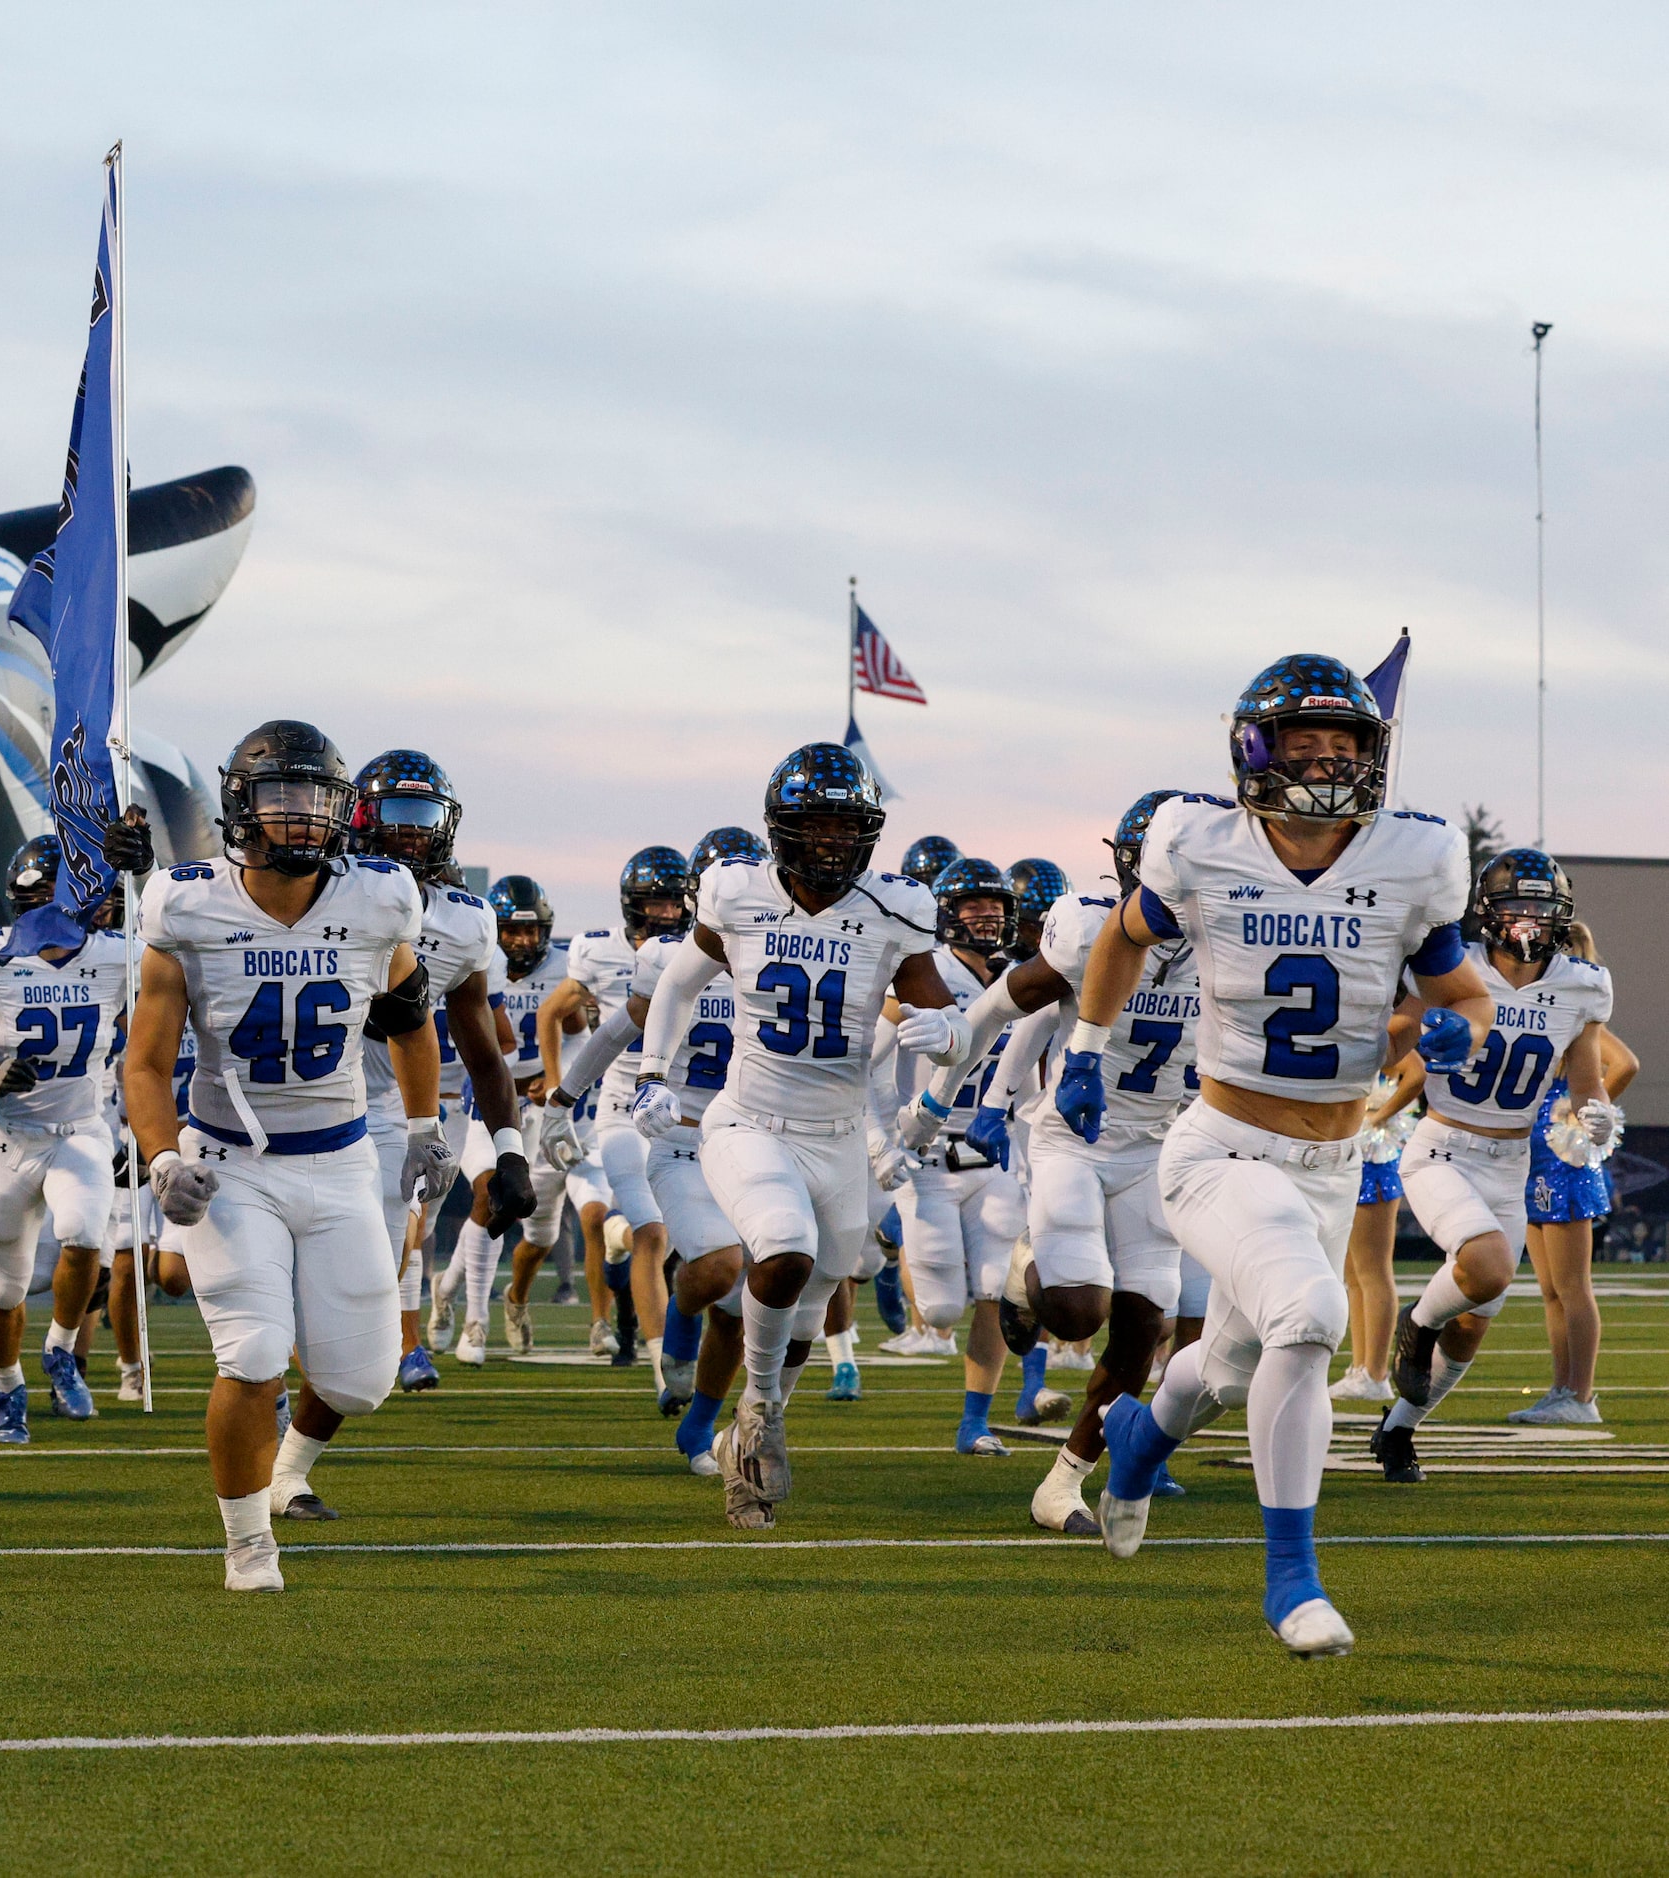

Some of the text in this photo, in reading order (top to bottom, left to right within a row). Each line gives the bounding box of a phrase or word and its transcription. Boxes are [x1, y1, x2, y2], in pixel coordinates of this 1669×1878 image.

[1308, 697, 1348, 707] Riddell
[765, 932, 852, 966] BOBCATS
[1242, 912, 1362, 949] BOBCATS
[244, 949, 338, 977] BOBCATS
[23, 984, 90, 1005] BOBCATS
[755, 961, 848, 1059] 31
[1123, 991, 1201, 1018] BOBCATS
[1261, 953, 1340, 1080] 2
[15, 1003, 101, 1081] 27
[228, 979, 351, 1083] 46
[1116, 1018, 1184, 1094] 7
[1447, 1029, 1555, 1110] 30
